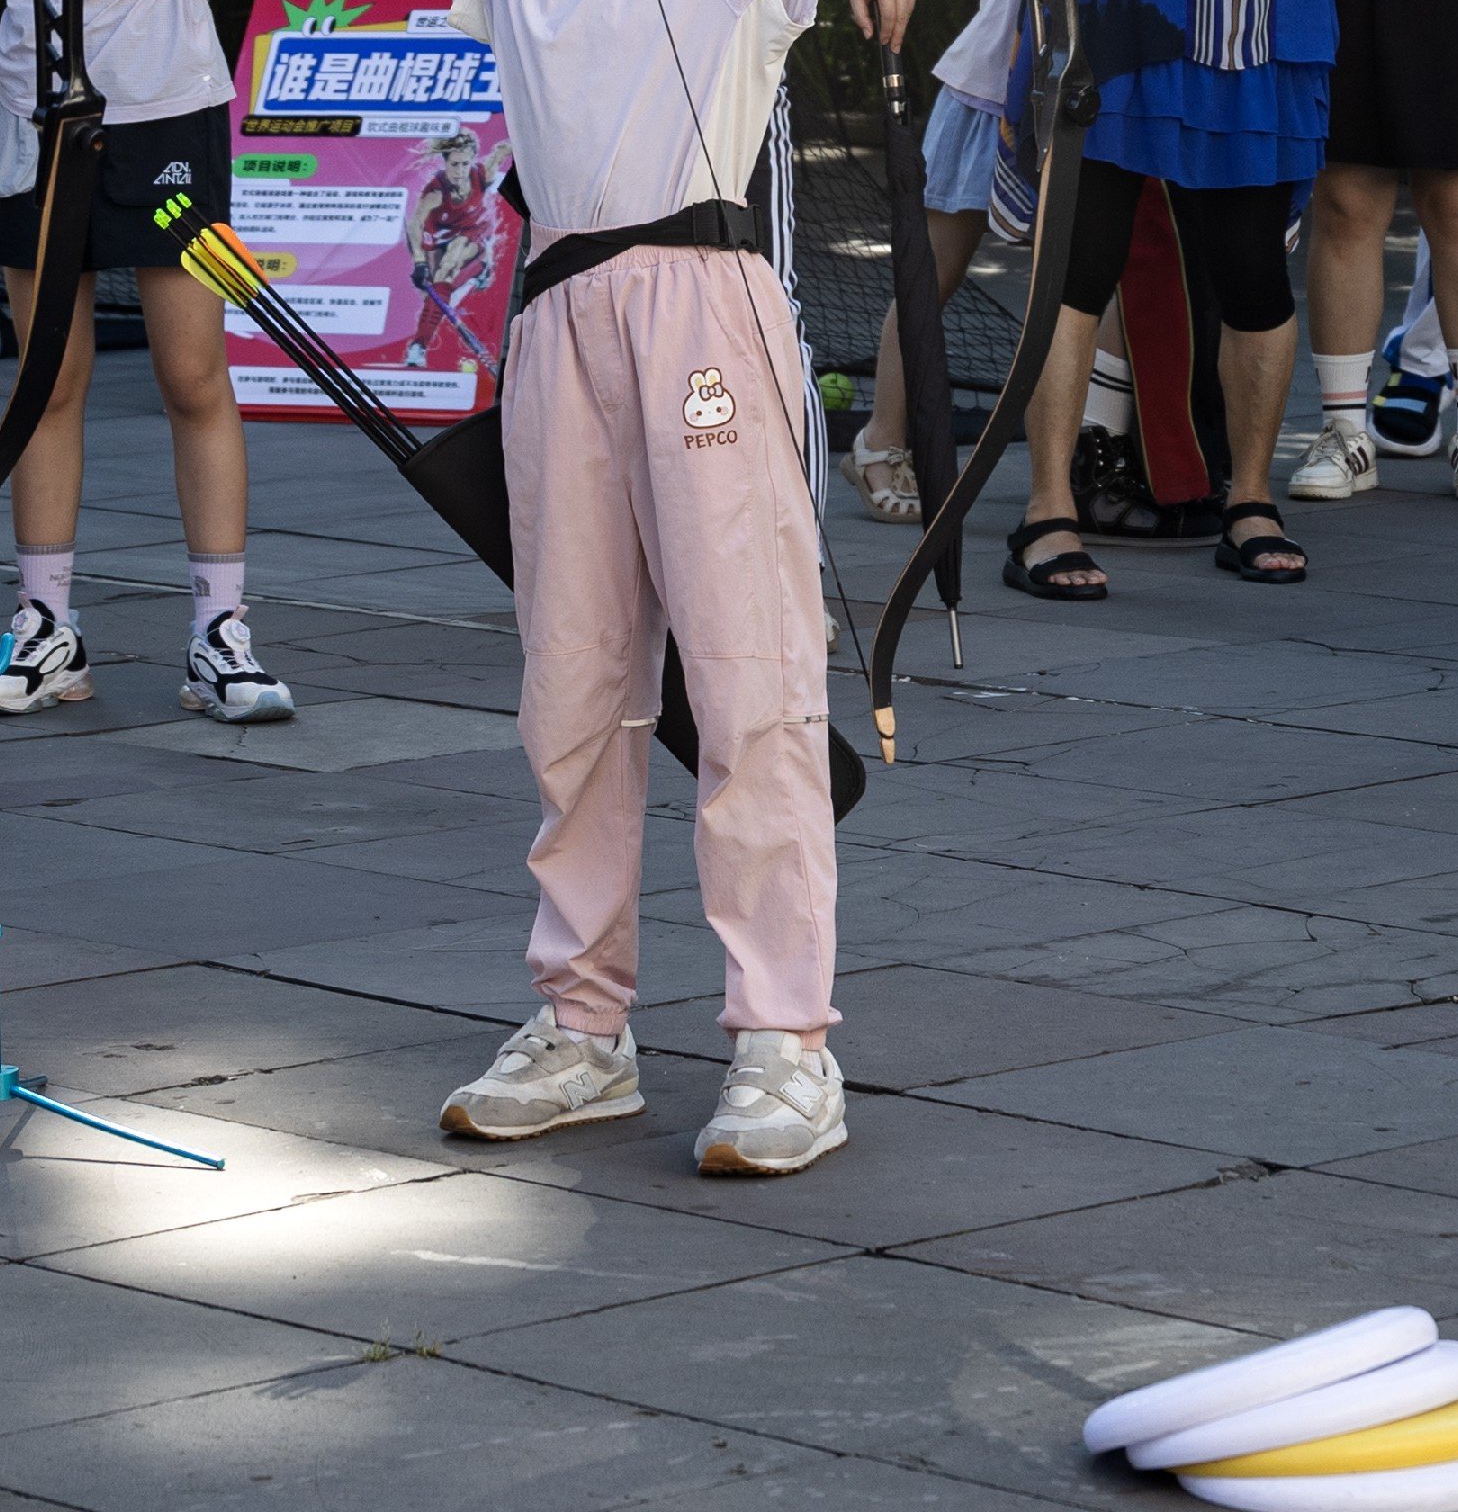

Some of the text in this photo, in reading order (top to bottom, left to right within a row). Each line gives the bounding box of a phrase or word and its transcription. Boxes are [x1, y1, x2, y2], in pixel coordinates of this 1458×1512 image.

[267, 52, 504, 103] 谁是曲棍球王
[683, 430, 738, 449] PEPCO
